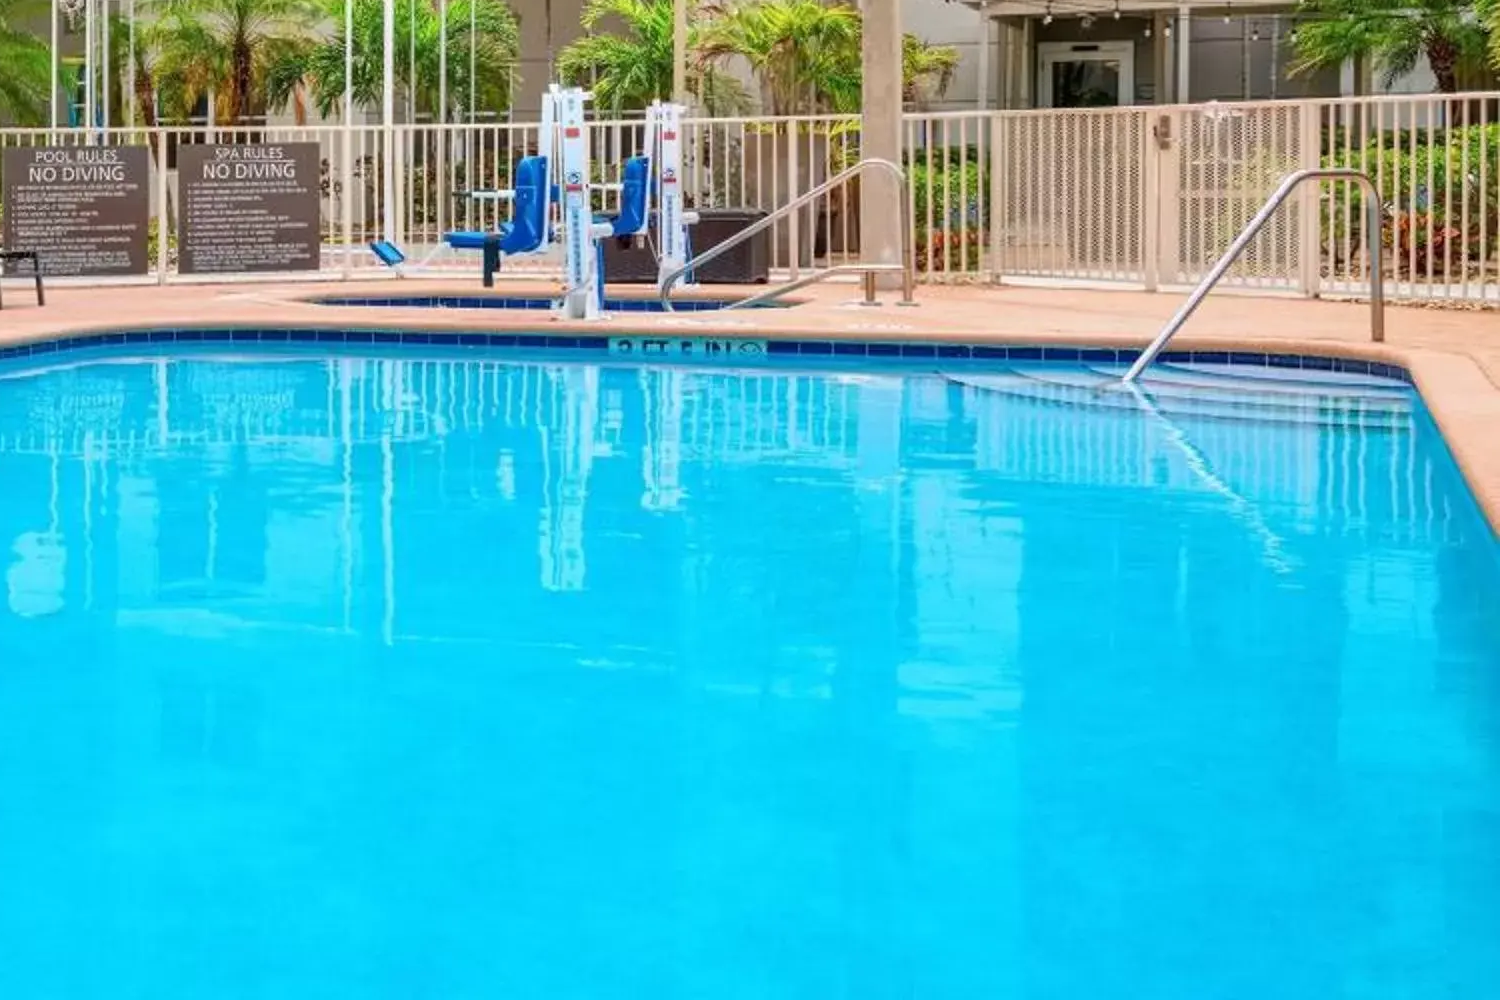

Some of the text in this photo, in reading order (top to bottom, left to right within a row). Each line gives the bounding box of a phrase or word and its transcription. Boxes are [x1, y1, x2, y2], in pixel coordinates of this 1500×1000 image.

[35, 149, 118, 163] POOL RULES
[214, 147, 283, 160] SPA RULES
[28, 165, 126, 183] NO DIVING
[203, 162, 296, 179] NO DIVING
